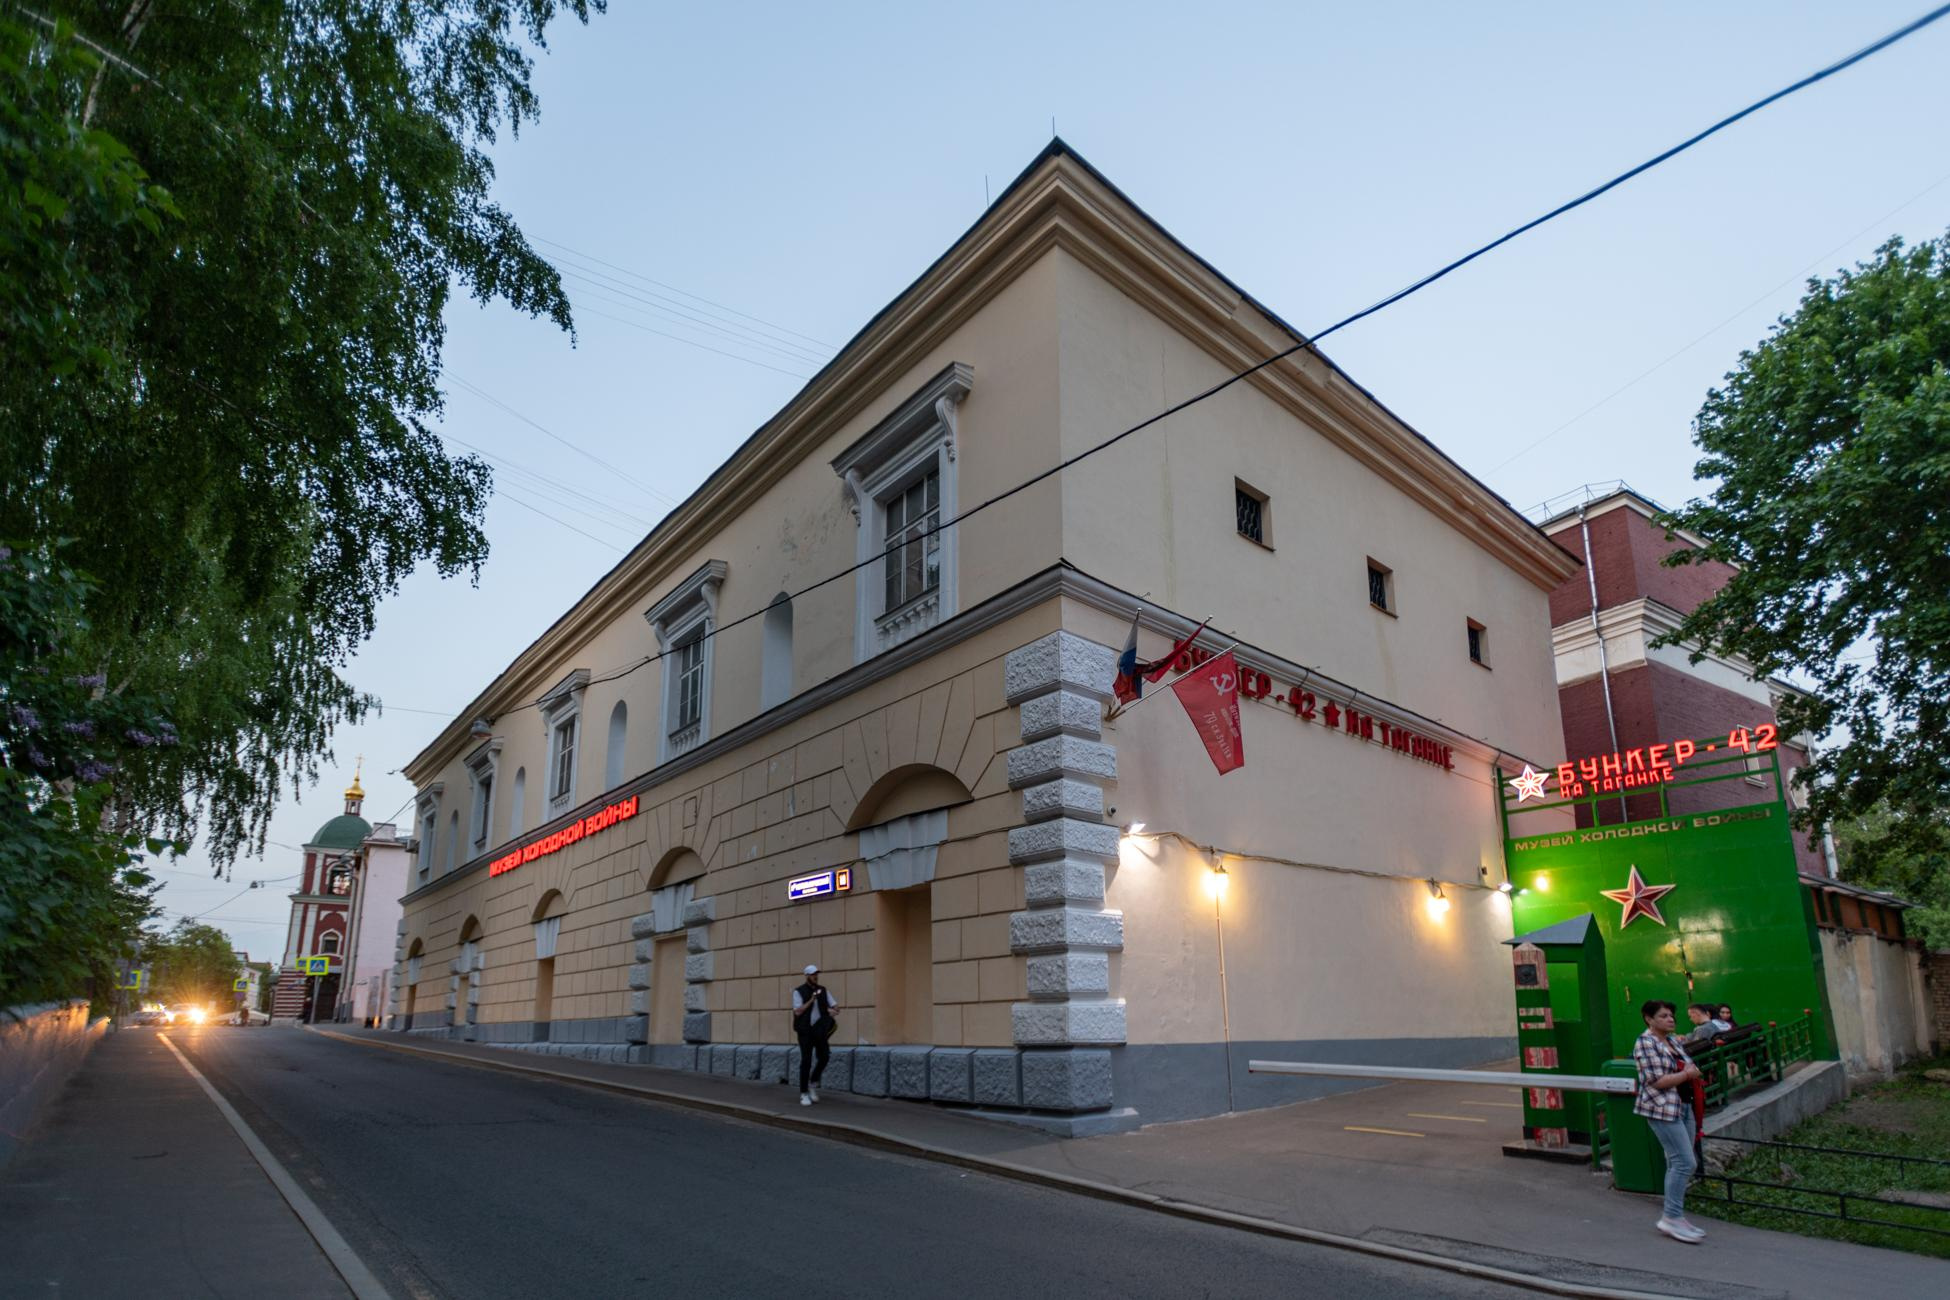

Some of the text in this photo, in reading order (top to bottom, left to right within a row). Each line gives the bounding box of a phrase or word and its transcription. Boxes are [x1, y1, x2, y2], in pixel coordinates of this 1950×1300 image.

[1345, 708, 1373, 740] НА
[1557, 740, 1695, 786] БУНКЕР
[1560, 766, 1675, 799] НА ТАГАНКЕ
[489, 795, 638, 878] МУЗЕЙ ХОЛОДНОЙ ВОЙНЫ
[1514, 835, 1575, 851] МУЗЕЙ
